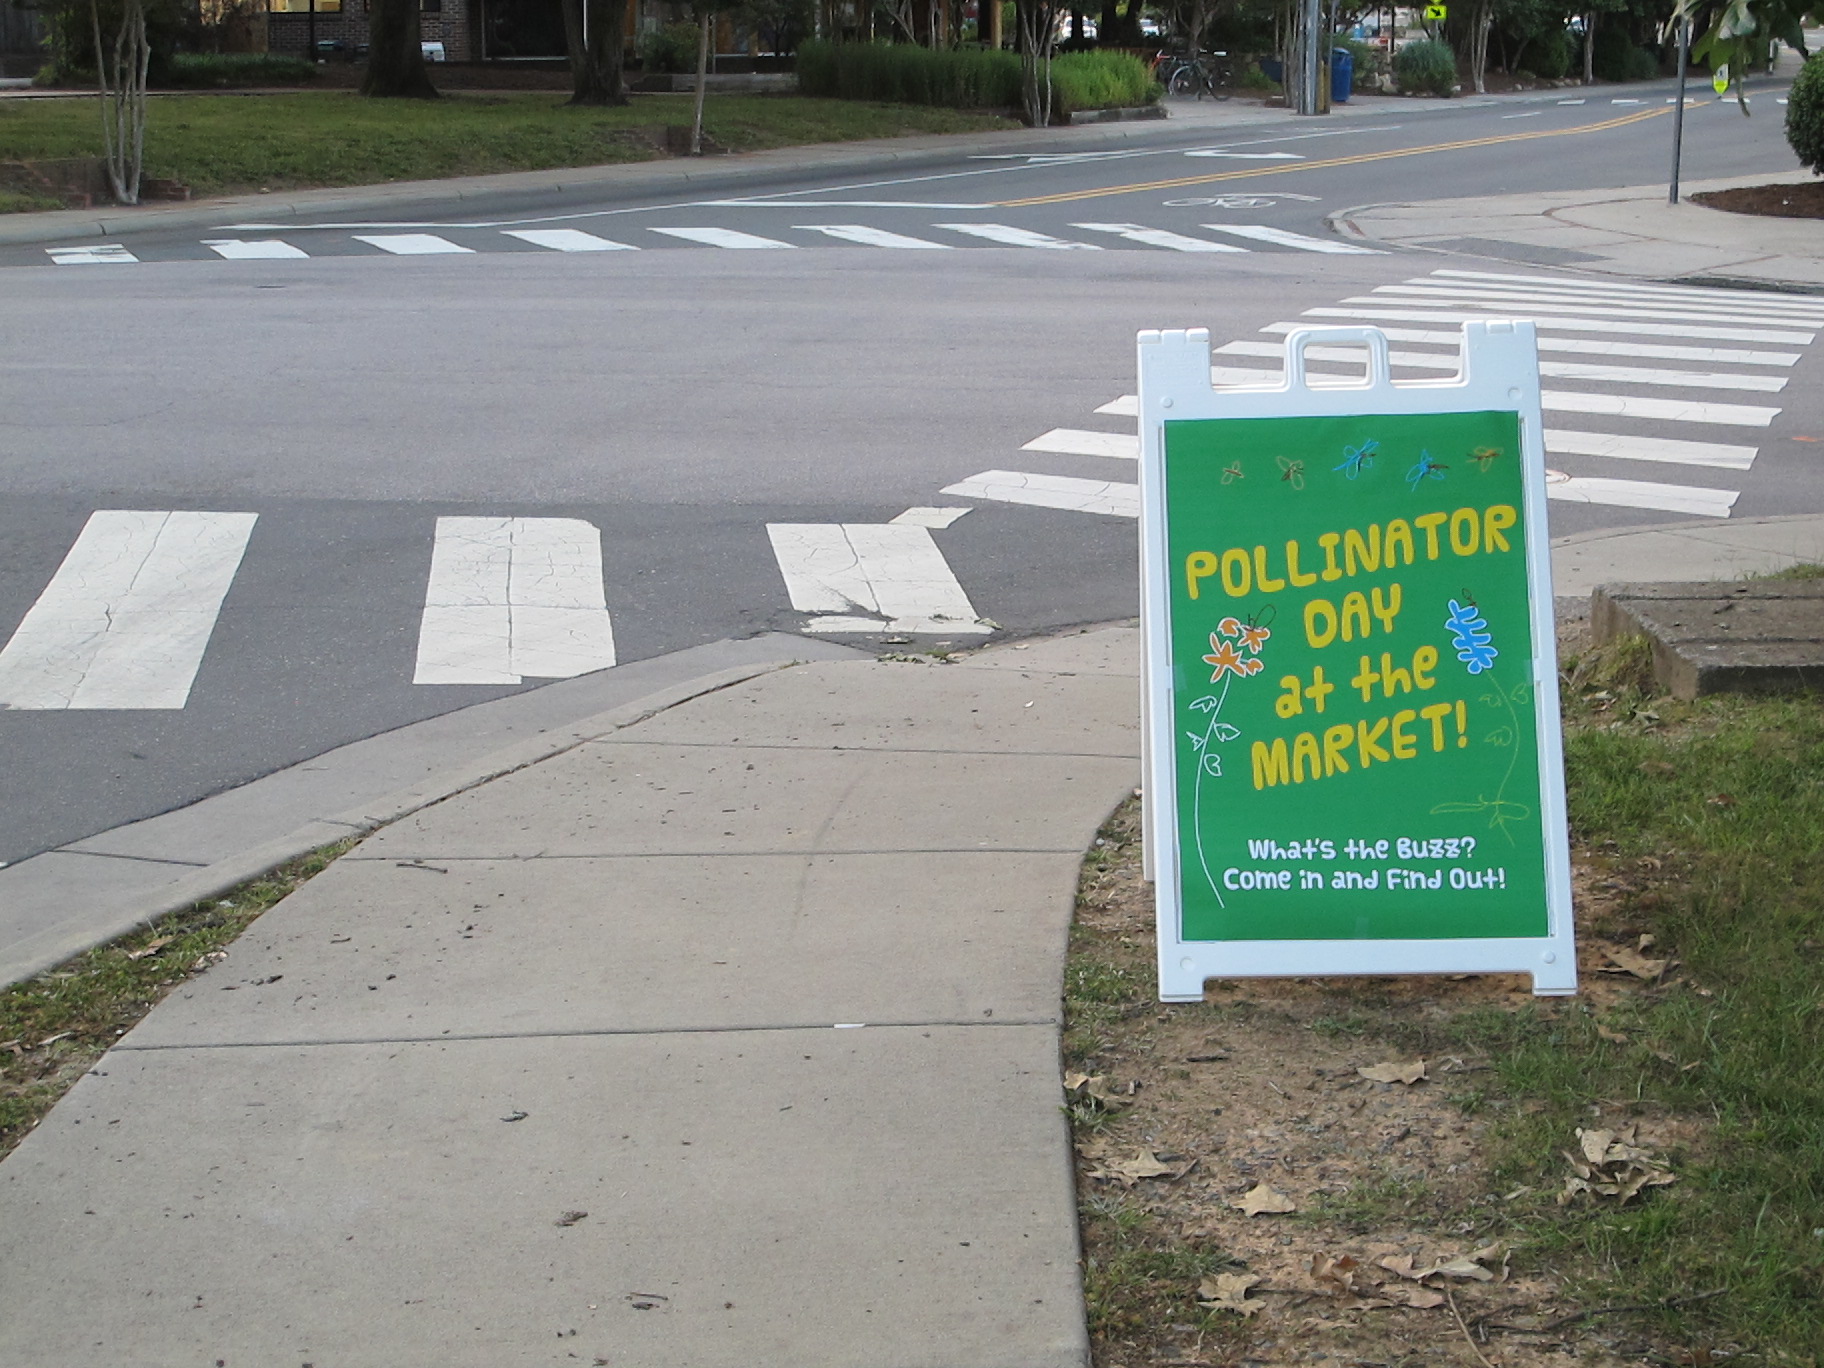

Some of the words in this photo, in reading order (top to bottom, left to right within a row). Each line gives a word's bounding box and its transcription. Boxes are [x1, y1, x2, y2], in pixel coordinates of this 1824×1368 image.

[1185, 504, 1517, 600] POLLINATOR
[1303, 583, 1403, 649] DAY
[1275, 665, 1335, 719] at
[1350, 645, 1439, 702] the
[1251, 699, 1468, 790] MARKET!
[1223, 867, 1292, 891] Come
[1299, 868, 1324, 890] in
[1331, 868, 1380, 890] and
[1386, 867, 1443, 890] Find
[1449, 867, 1507, 890] Out!
[1247, 838, 1337, 861] What's
[1343, 838, 1389, 860] the
[1396, 836, 1477, 859] Buzz?
